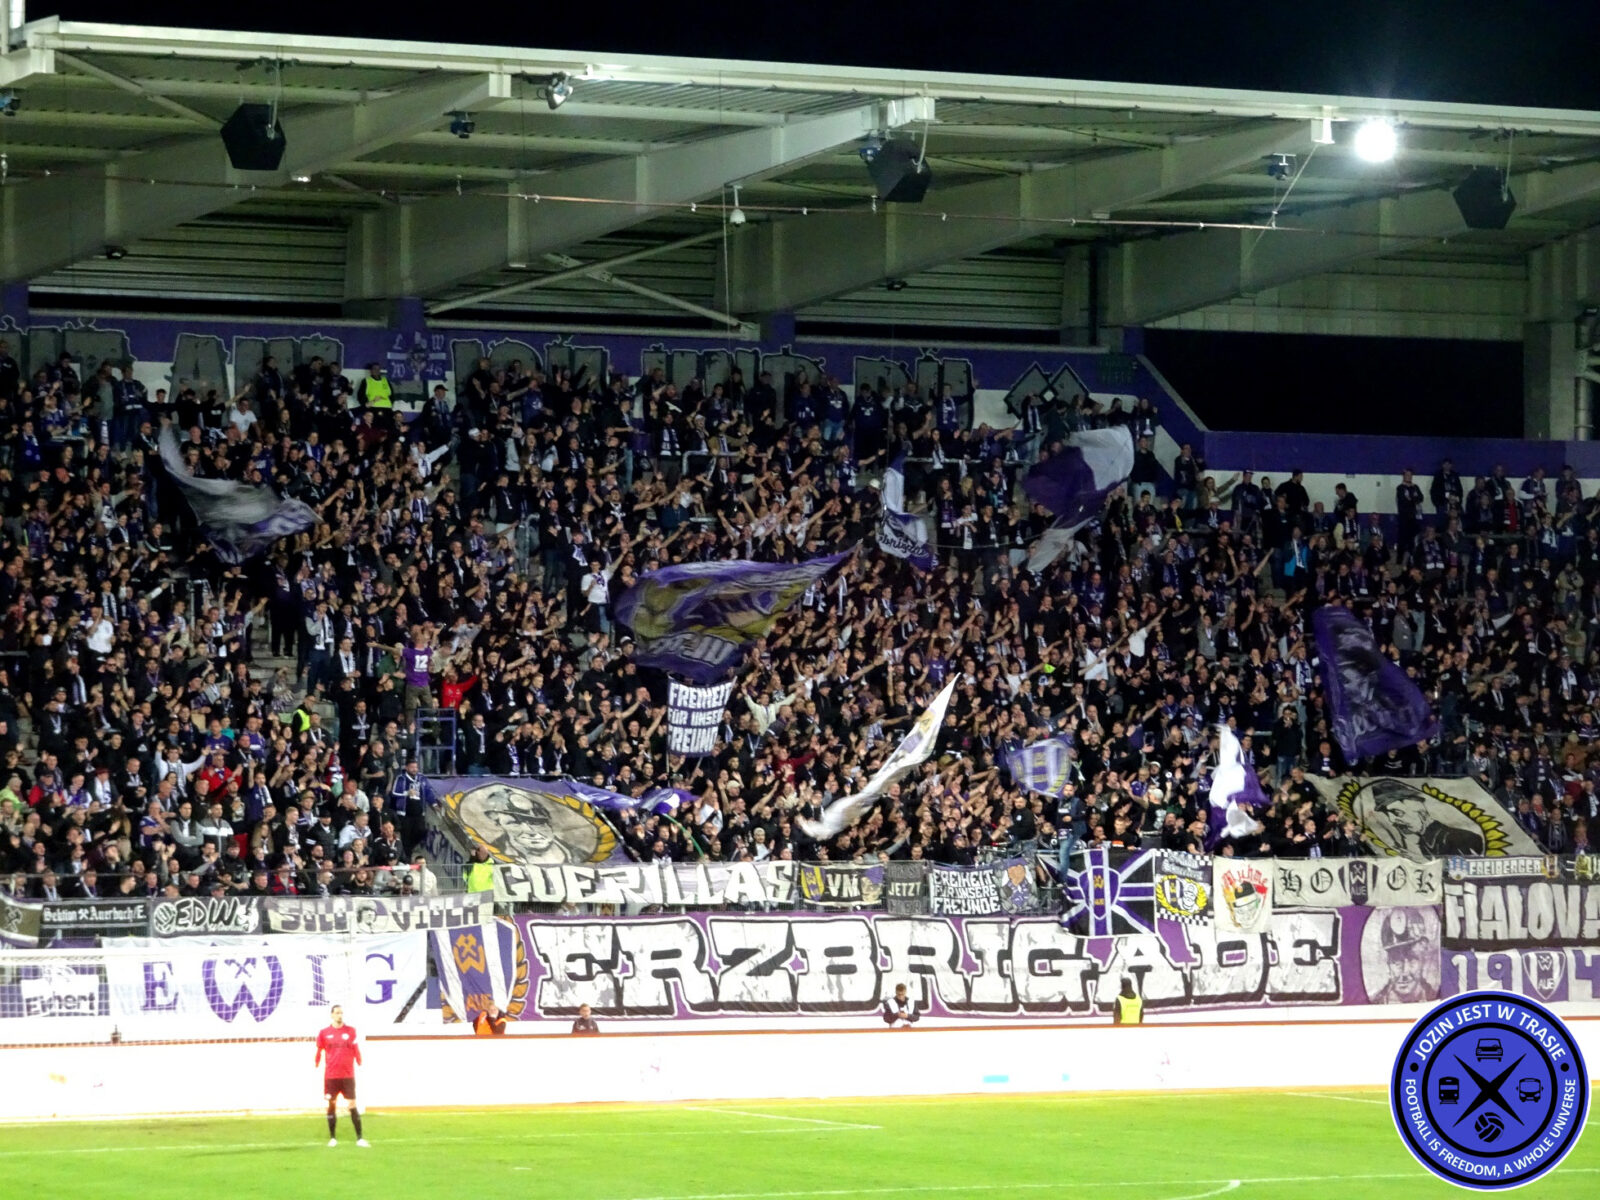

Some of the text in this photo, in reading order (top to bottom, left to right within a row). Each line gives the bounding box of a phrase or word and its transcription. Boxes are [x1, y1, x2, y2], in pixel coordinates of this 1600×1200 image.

[415, 655, 428, 669] 12
[668, 682, 733, 709] FREIHEIT
[499, 863, 792, 904] GUERILLAS
[887, 881, 922, 897] JETZT
[932, 868, 994, 887] FREIHEIT
[390, 896, 480, 932] VIOLA
[933, 896, 1001, 915] FREUNDE
[530, 917, 1343, 1018] ERZBRIGADE
